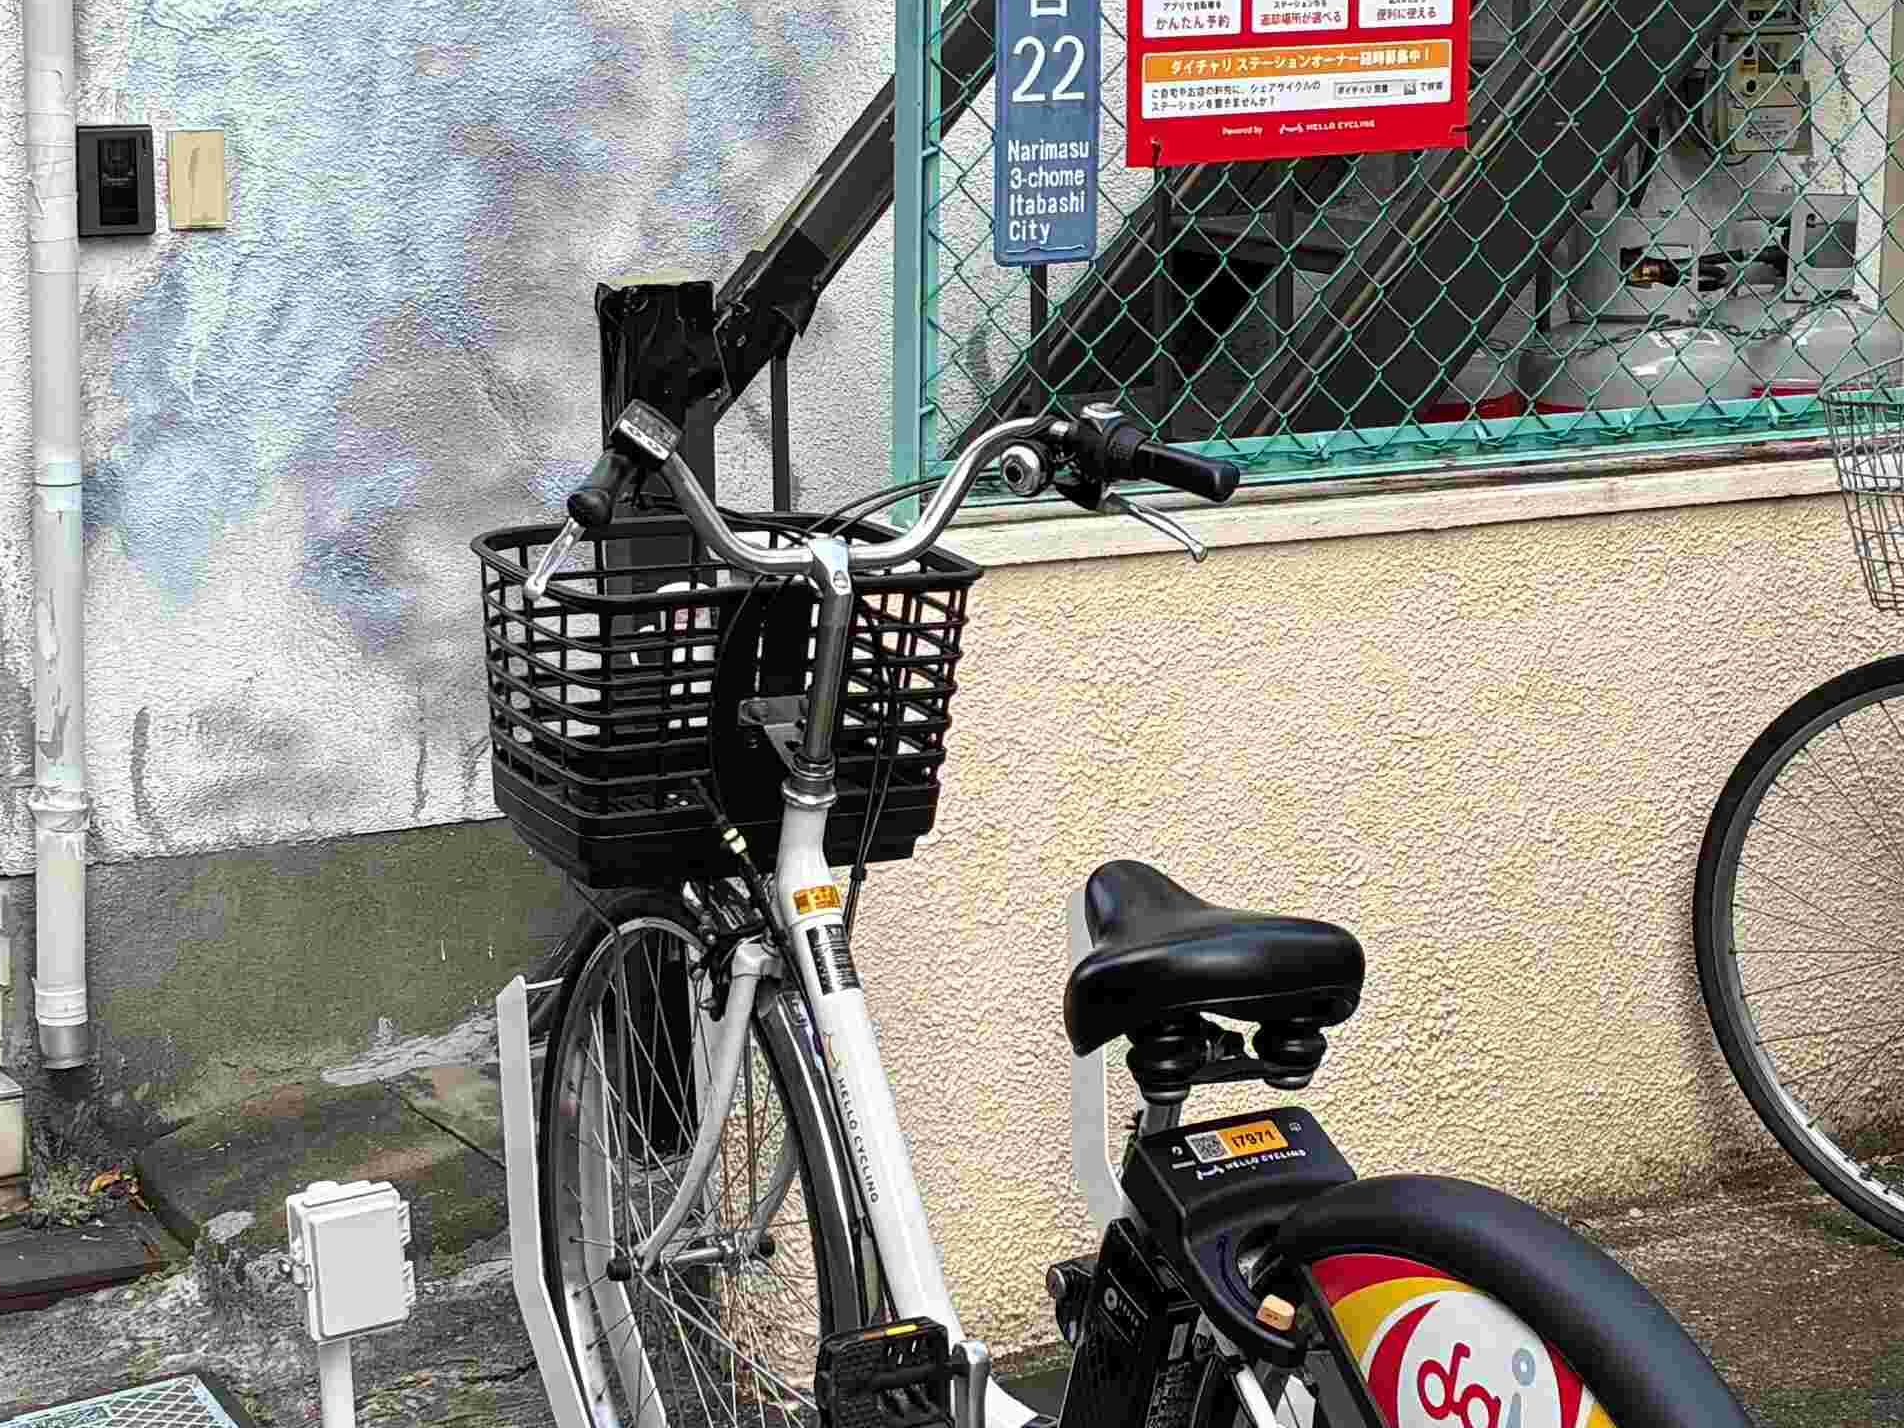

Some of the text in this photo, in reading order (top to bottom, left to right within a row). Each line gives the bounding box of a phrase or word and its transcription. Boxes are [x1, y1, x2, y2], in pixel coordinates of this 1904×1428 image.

[1011, 34, 1086, 103] 22
[1171, 57, 1233, 76] ダイチャリ
[1007, 139, 1090, 163] Narimasu
[1009, 165, 1085, 189] 3-chome
[1009, 189, 1085, 216] Itabashi
[1008, 220, 1052, 245] City
[837, 1077, 858, 1130] HELLO
[1225, 1156, 1259, 1171] HELLO
